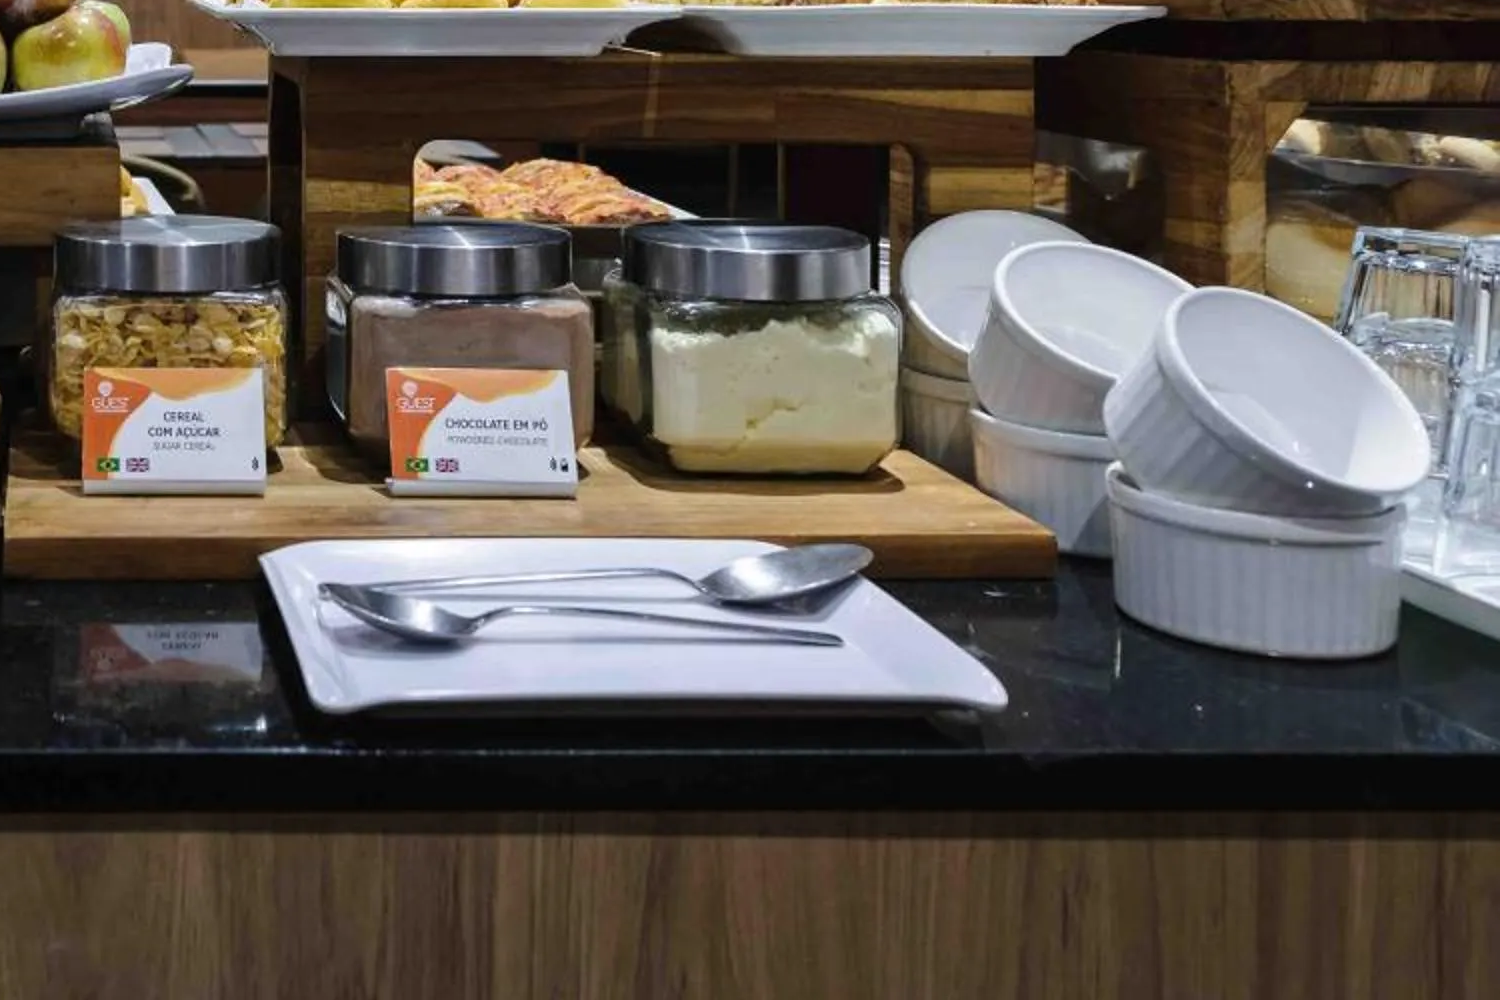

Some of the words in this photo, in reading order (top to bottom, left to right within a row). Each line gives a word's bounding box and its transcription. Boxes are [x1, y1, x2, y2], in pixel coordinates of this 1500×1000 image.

[163, 411, 204, 423] CEREAL
[445, 417, 510, 430] CHOCOLATE
[513, 418, 529, 430] EM
[148, 426, 173, 438] COM
